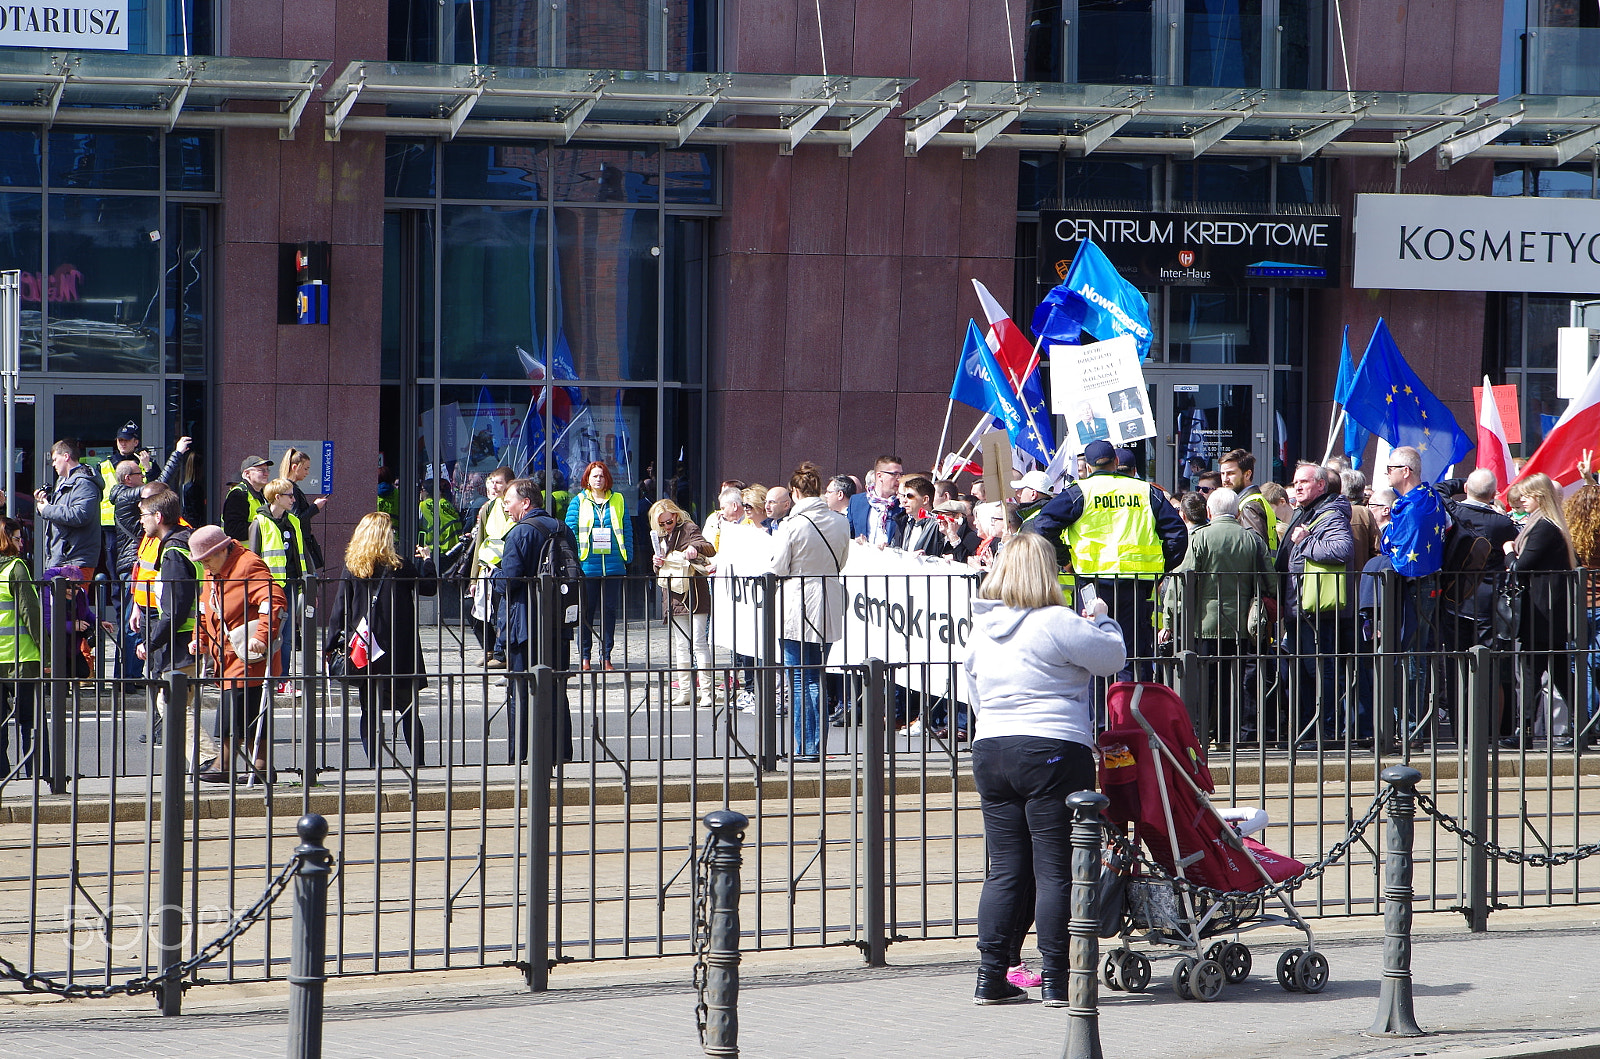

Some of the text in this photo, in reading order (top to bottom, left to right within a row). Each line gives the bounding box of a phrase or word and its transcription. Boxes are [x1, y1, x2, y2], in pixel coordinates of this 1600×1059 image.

[1055, 218, 1329, 246] CENTRUM KREDYTOWE
[1160, 267, 1211, 279] Inter-Haus
[1094, 495, 1140, 508] POLICJA
